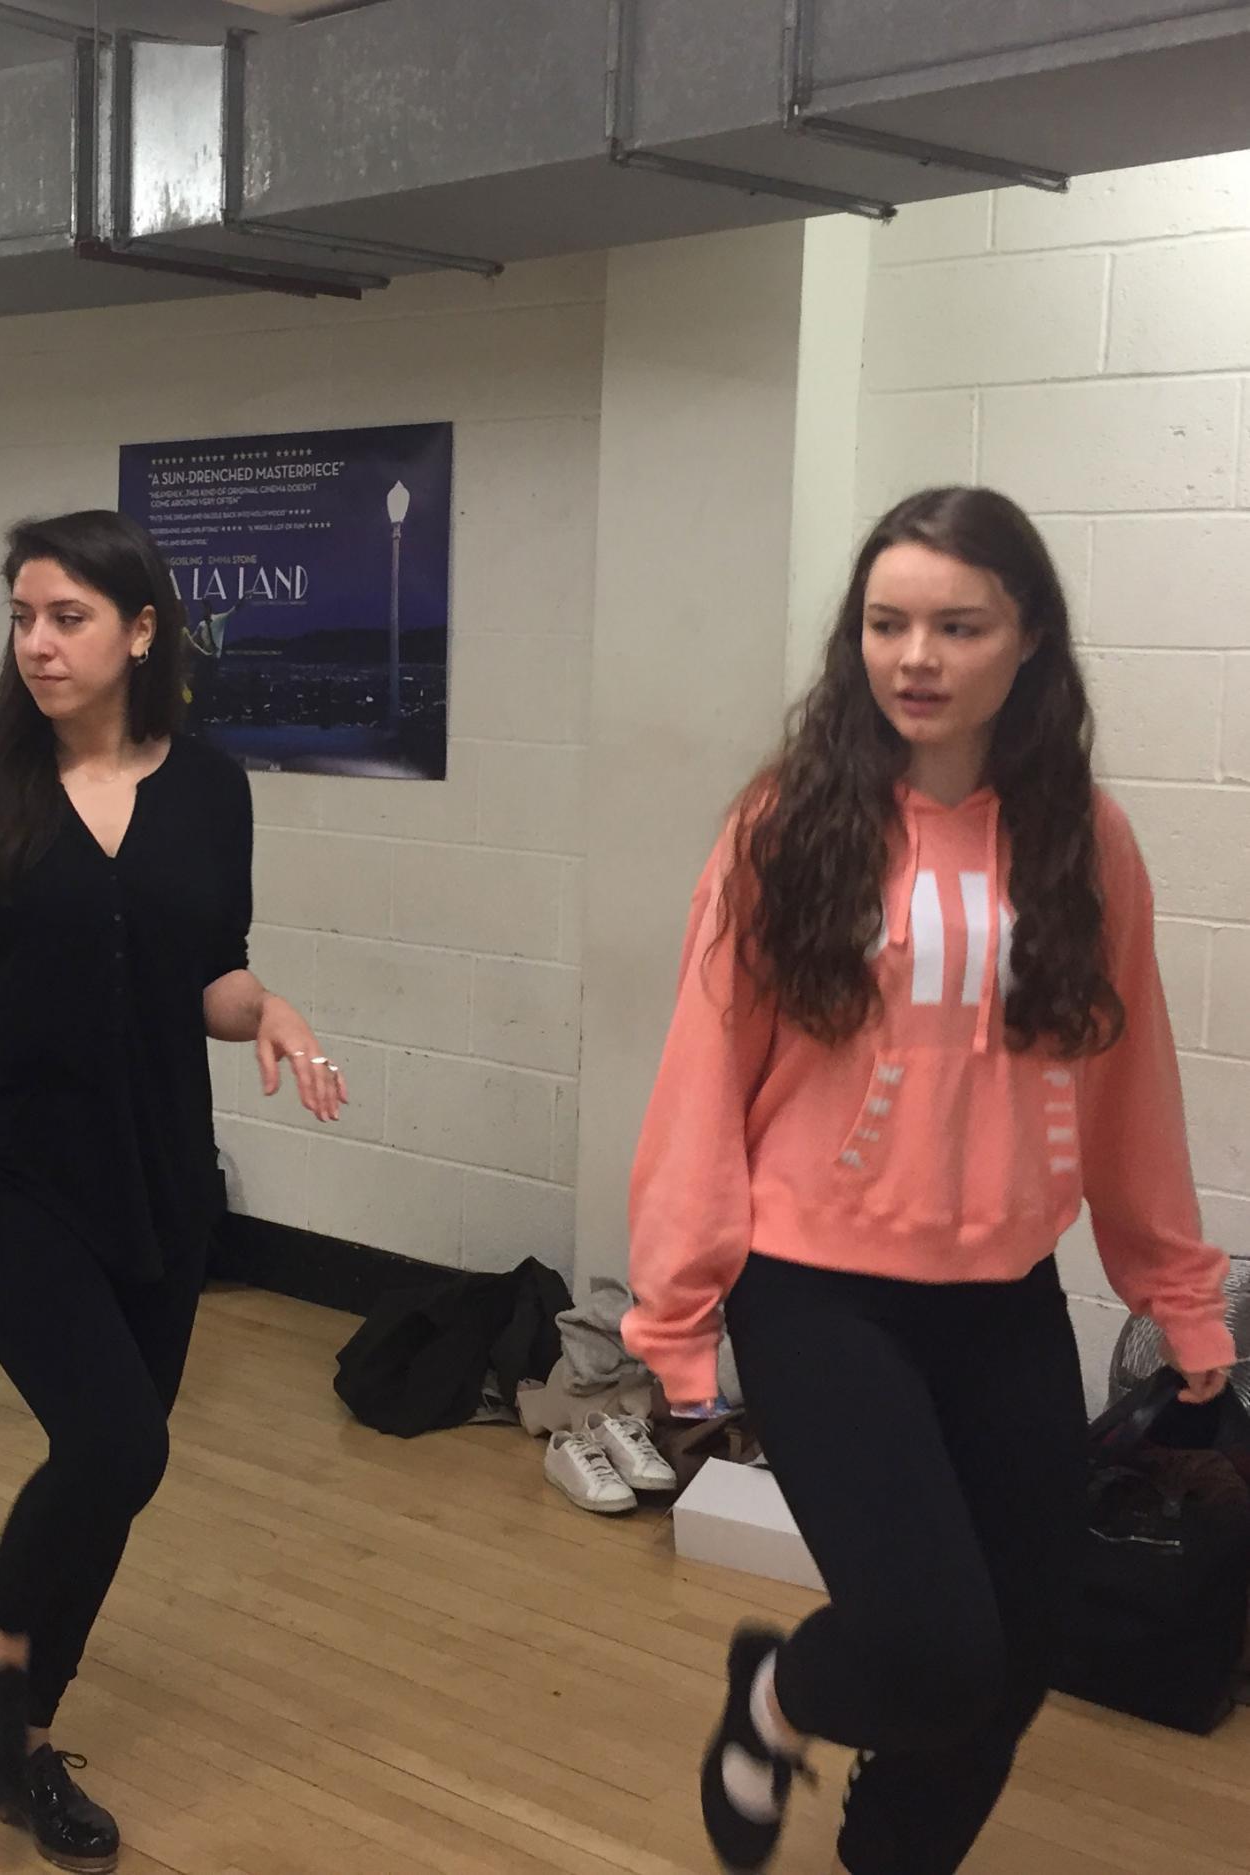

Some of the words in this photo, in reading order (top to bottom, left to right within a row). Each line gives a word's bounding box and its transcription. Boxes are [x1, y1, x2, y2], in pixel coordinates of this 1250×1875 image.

[161, 467, 253, 485] SUN-DRENCHED
[255, 461, 346, 480] MASTERPIECE"
[192, 567, 227, 601] LA
[238, 564, 309, 600] LAND
